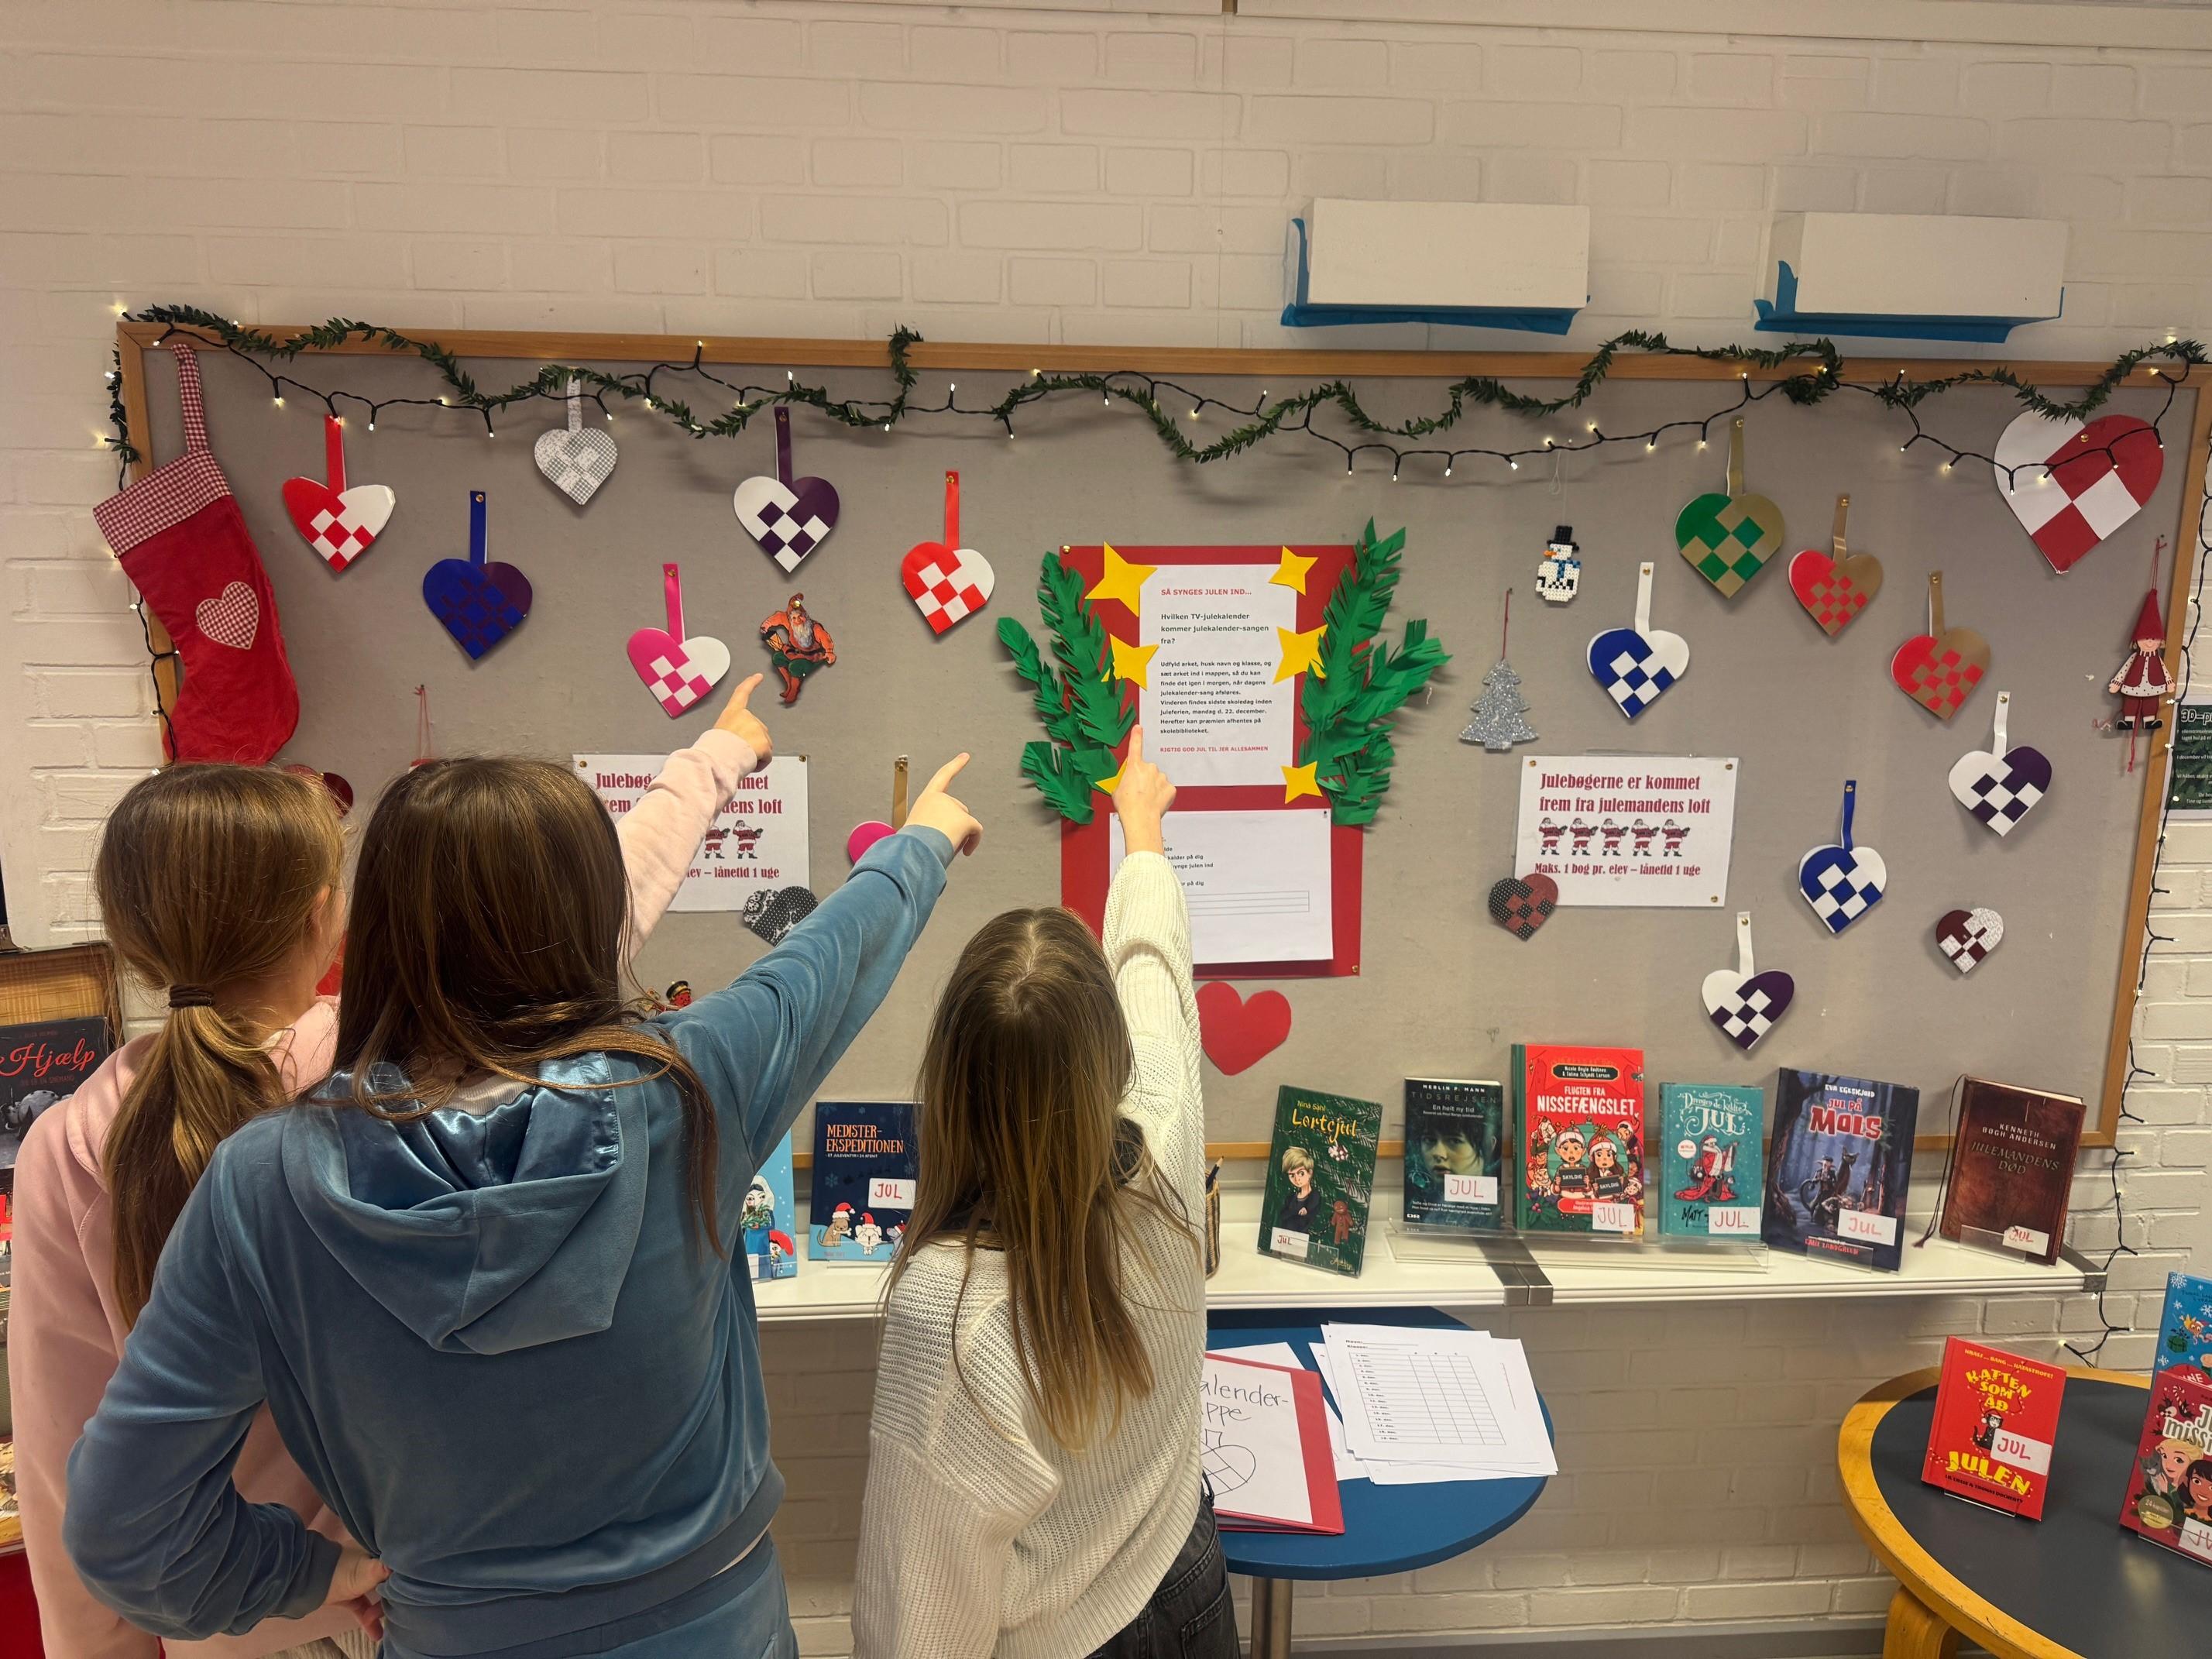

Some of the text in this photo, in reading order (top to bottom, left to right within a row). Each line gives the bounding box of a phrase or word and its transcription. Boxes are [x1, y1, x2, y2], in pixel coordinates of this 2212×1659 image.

[596, 773, 655, 788] Julebøg
[1540, 773, 1700, 790] Julebøgerne er kommet
[759, 799, 781, 814] loft
[1539, 796, 1711, 813] frem fra julemandens loft
[715, 866, 750, 878] lånetid
[753, 868, 757, 878] 1
[761, 868, 780, 880] uge
[1534, 863, 1561, 874] Maks.
[1565, 864, 1568, 874] 1
[1571, 863, 1589, 875] bog
[1592, 865, 1606, 876] pr.
[1609, 864, 1627, 874] elev
[1640, 863, 1673, 875] lånetid
[1675, 865, 1679, 875] 1
[1683, 865, 1701, 877] uge
[5, 1038, 94, 1077] Hjælp
[1412, 1091, 1496, 1104] TIDSREJSEN
[1564, 1086, 1606, 1096] FLUGTEN FRA
[1297, 1100, 1311, 1109] Nina
[1537, 1095, 1636, 1115] NISSEFÆNGSLET
[1828, 1097, 1863, 1111] JUL PÅ
[1685, 1107, 1745, 1136] JUL
[1809, 1105, 1882, 1140] MOLS
[827, 1124, 883, 1139] MEDISTER-
[1999, 1123, 2039, 1138] KENNETH
[826, 1139, 905, 1153] EKSPEDITIONEN
[2009, 1133, 2056, 1150] ANDERSEN
[1971, 1142, 2060, 1171] JULEMANDENS
[1998, 1160, 2026, 1175] DØD
[874, 1183, 902, 1199] JUL
[1450, 1179, 1484, 1197] JUL
[1598, 1207, 1627, 1228] JUL
[1715, 1211, 1749, 1228] JUL
[1848, 1217, 1882, 1235] JUL
[1277, 1235, 1292, 1245] JUL
[1990, 1356, 2007, 1365] BANG
[1966, 1369, 2032, 1398] KATTEN
[1980, 1381, 2014, 1400] SOM
[1997, 1437, 2031, 1460] JUL
[1946, 1451, 2031, 1496] JULEN
